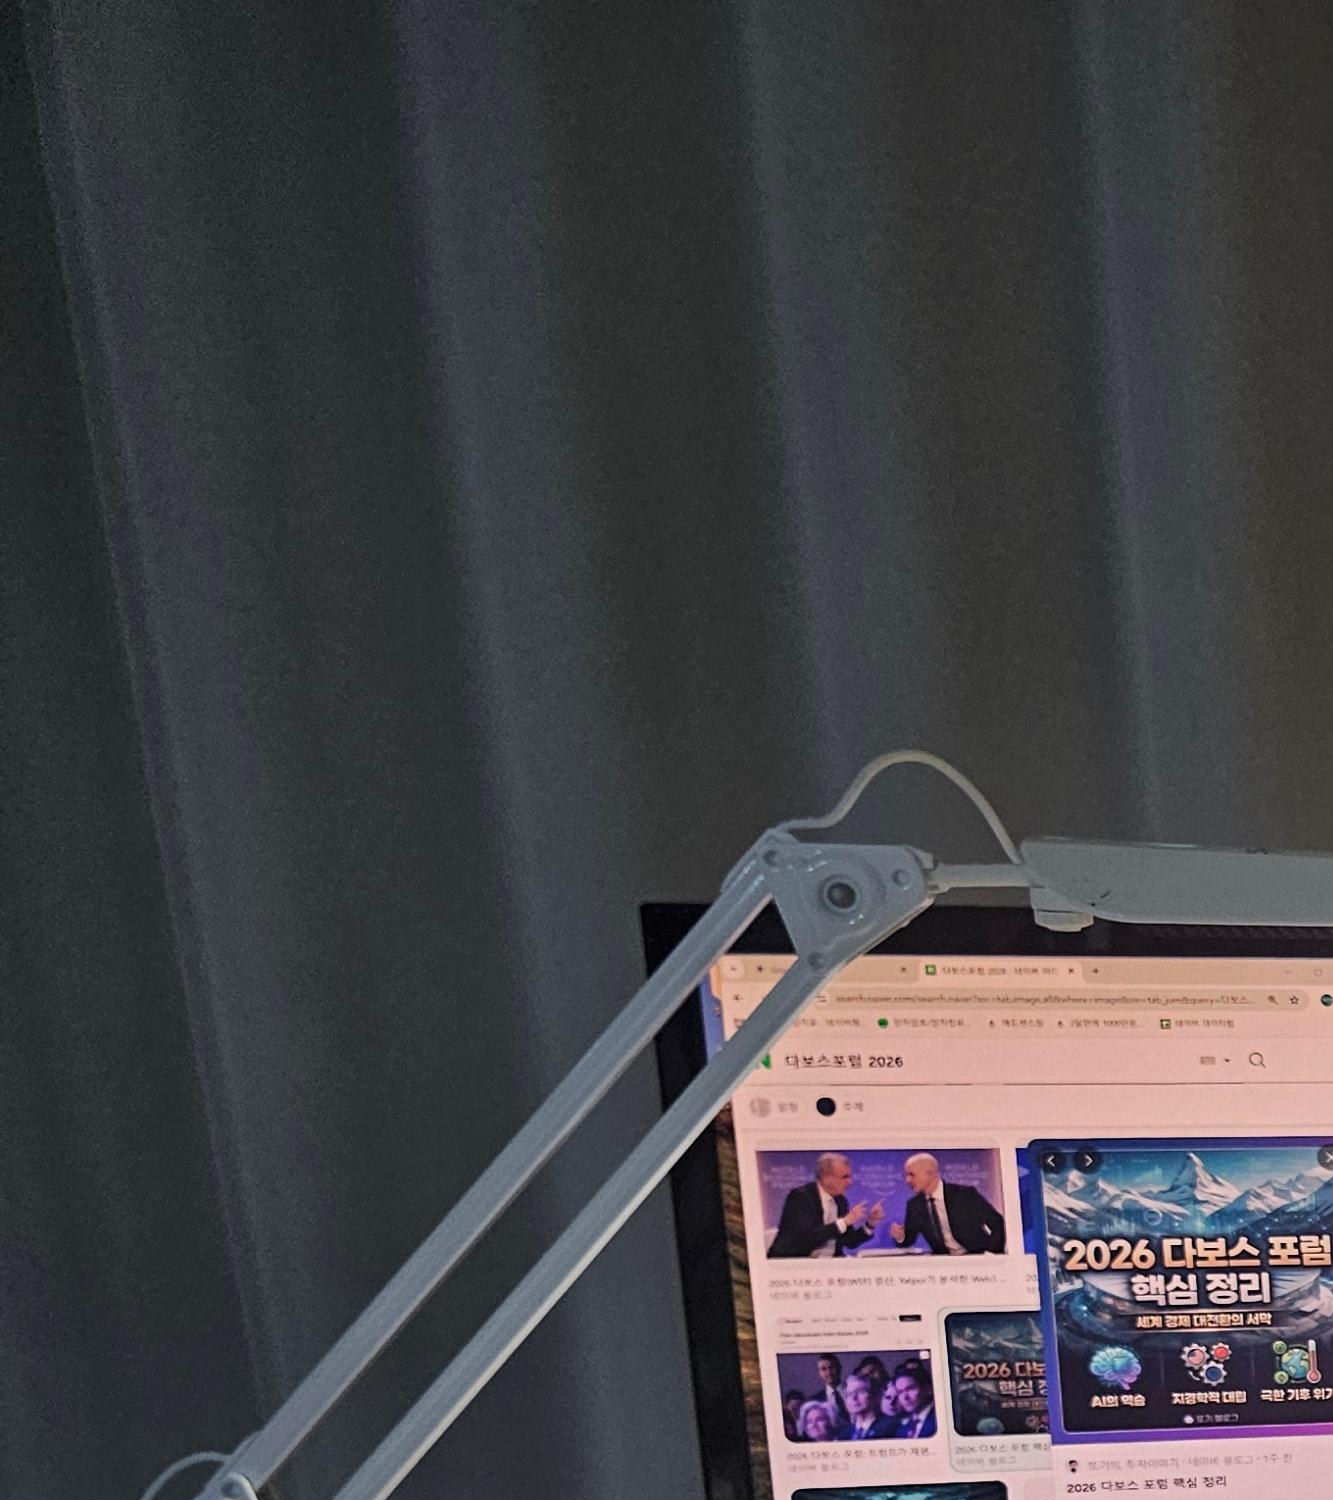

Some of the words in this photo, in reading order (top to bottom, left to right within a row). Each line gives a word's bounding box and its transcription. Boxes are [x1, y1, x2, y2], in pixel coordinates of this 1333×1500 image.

[784, 1055, 861, 1068] 다보스포럼
[869, 1056, 903, 1068] 2026
[1064, 1238, 1156, 1271] 2026
[1163, 1237, 1260, 1268] 다보스
[1267, 1235, 1332, 1267] 포럼
[1131, 1274, 1198, 1305] 핵심
[1206, 1272, 1270, 1304] 정리
[1246, 1313, 1271, 1326] 서막
[964, 1363, 1010, 1380] 2026
[999, 1380, 1033, 1397] 핵심
[1261, 1390, 1284, 1402] 극한
[1287, 1389, 1310, 1401] 기후
[1067, 1482, 1096, 1494] 2026
[1101, 1479, 1139, 1492] 다보스
[1144, 1478, 1167, 1490] 포럼
[1204, 1474, 1227, 1488] 정리
